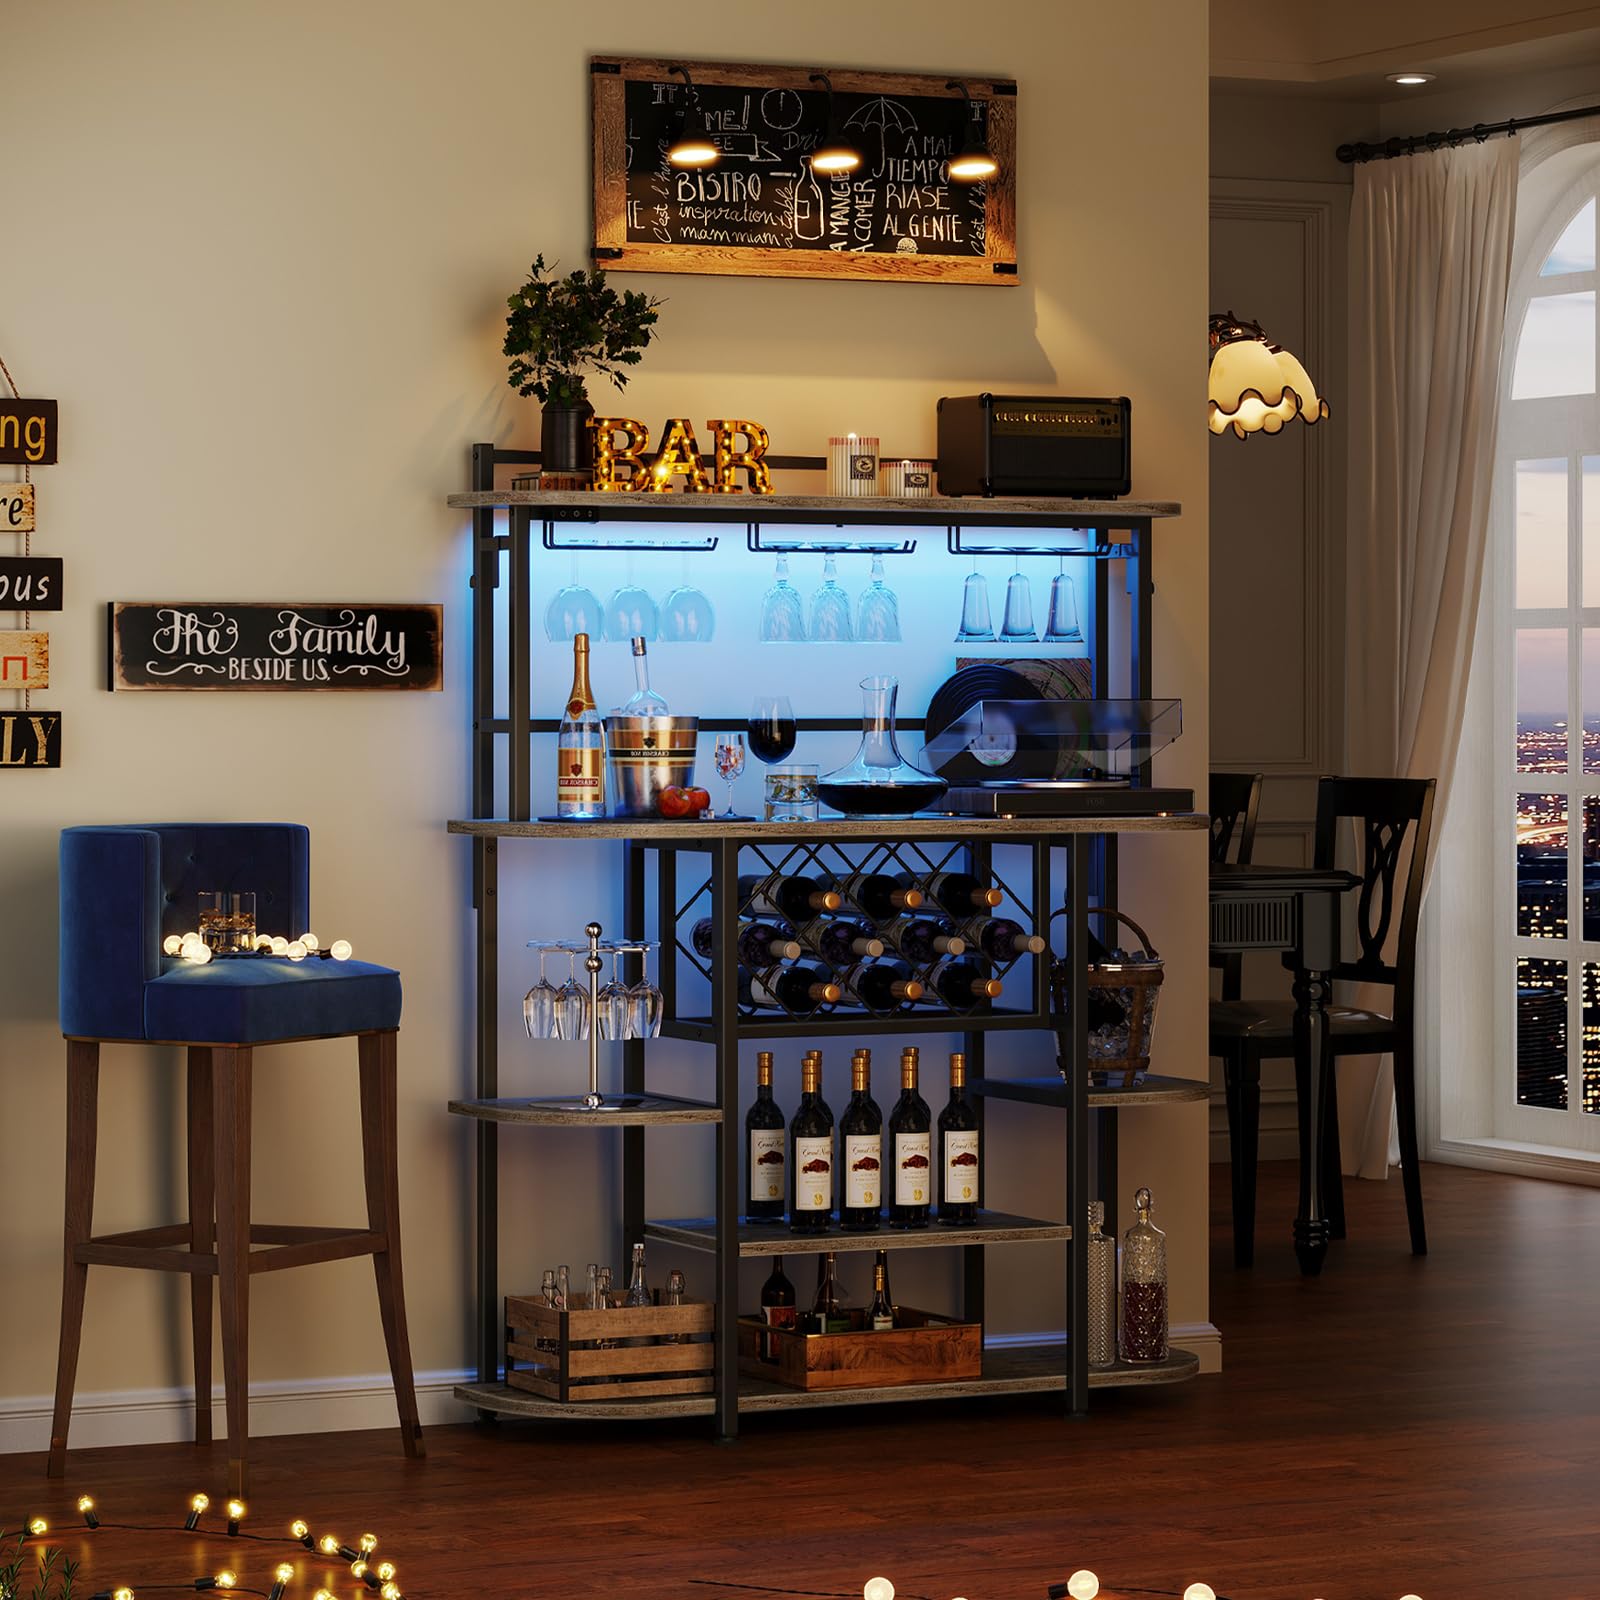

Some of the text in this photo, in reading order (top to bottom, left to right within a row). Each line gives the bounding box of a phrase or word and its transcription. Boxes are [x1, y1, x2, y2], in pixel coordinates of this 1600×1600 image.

[904, 135, 918, 157] A
[887, 158, 952, 184] TIEMPO
[853, 179, 877, 242] COMER
[886, 183, 951, 210] RIASE
[882, 213, 964, 242] AL GENTE
[586, 416, 776, 495] BAR
[153, 608, 406, 669] The Family
[228, 657, 297, 681] BESIDE
[0, 716, 58, 765] LY
